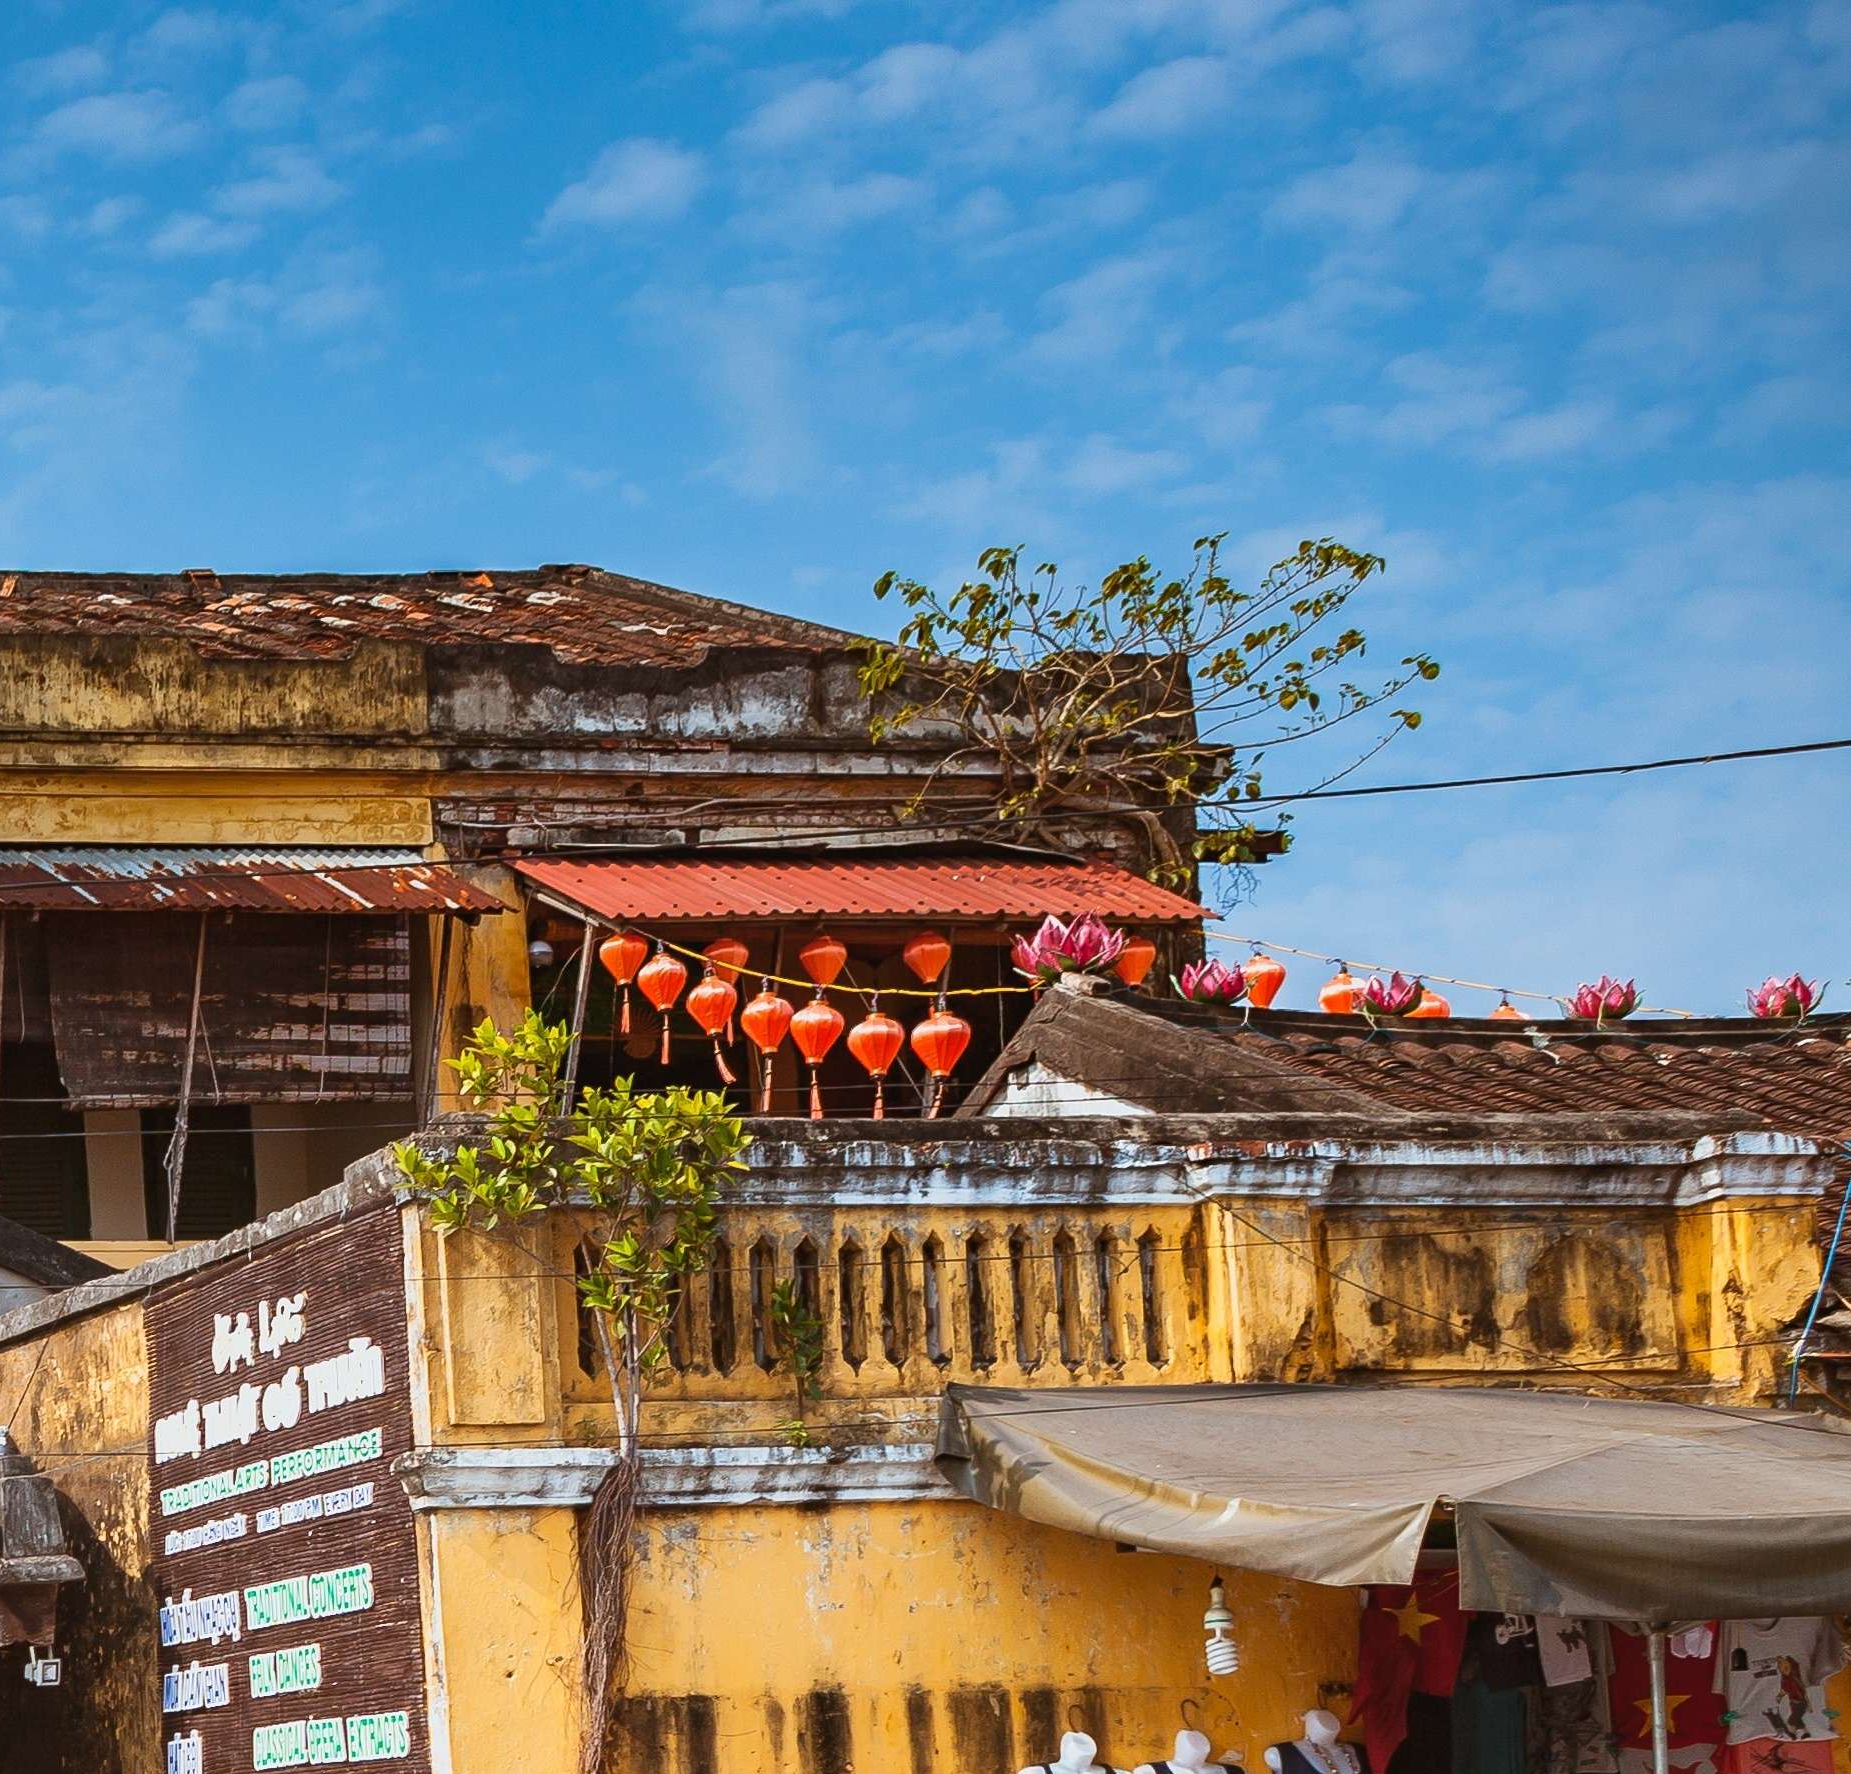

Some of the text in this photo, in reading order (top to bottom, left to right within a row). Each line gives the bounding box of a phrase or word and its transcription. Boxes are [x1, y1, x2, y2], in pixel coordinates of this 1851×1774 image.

[160, 1427, 383, 1516] TRADITIONAL ARTS PERFORMANCE
[323, 1488, 353, 1516] EVERY
[352, 1482, 375, 1509] DAY
[309, 1563, 374, 1618] CONCERTS
[249, 1652, 277, 1698] FOLK
[275, 1643, 322, 1693] DANCES
[253, 1720, 308, 1771] CLASSICAL
[307, 1717, 347, 1765] OPERA
[346, 1711, 410, 1763] EXTRACTS
